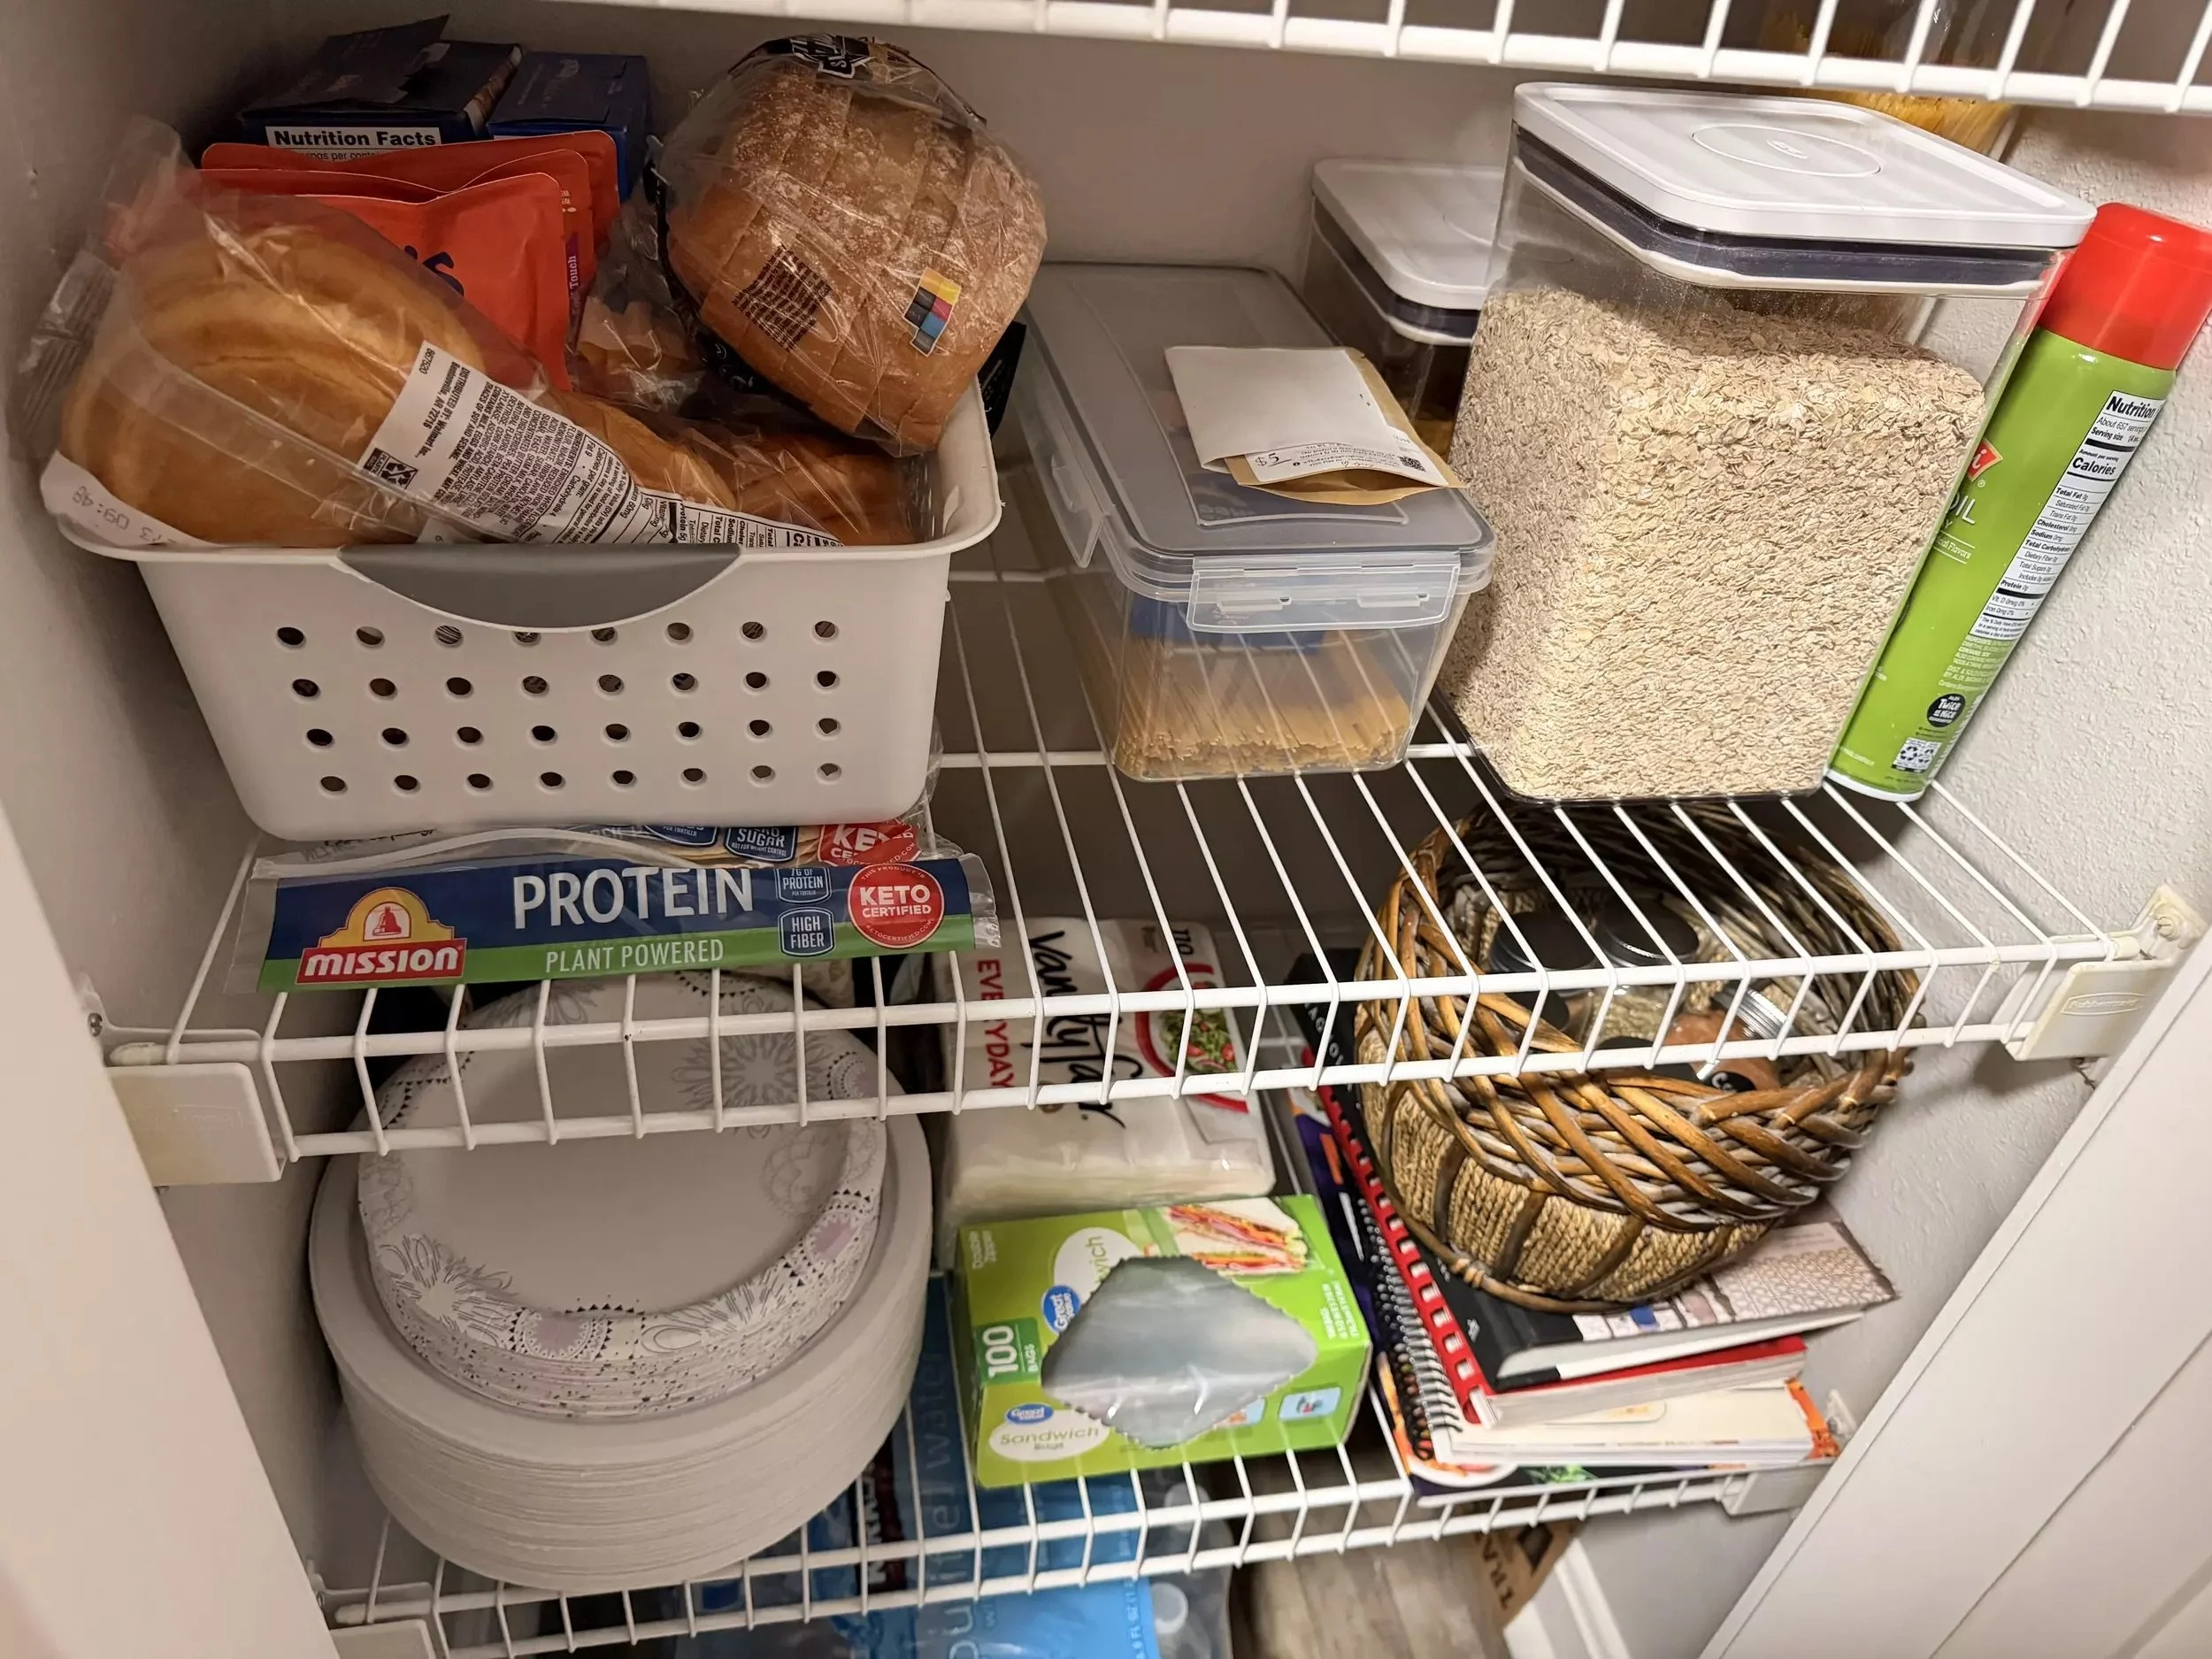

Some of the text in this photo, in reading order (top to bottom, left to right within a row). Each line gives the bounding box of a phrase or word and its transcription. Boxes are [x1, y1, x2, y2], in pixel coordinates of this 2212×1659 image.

[273, 130, 435, 146] Nutrition Facts
[331, 152, 347, 161] per
[567, 255, 580, 289] Touch
[424, 365, 471, 448] DISTRIBUTED BY: Walmart
[482, 384, 502, 414] CONTAINS
[2105, 395, 2157, 419] Nutrition
[421, 395, 444, 429] AR 72716
[448, 380, 493, 462] TRACES OF SOY AND SESAME.
[474, 411, 489, 431] MILK,
[521, 404, 534, 419] AND
[2095, 415, 2128, 430] About 657
[450, 388, 510, 492] XYLANASE, ASCORBIC ACID, PROTEASE,
[462, 394, 517, 491] DEXTROSE, CORN STARCH, AMYLASE,
[468, 428, 481, 447] EGGS
[505, 417, 528, 458] DIGLYCERIDES,
[2090, 426, 2114, 440] Serving
[2112, 432, 2124, 441] size
[461, 444, 474, 460] AND
[472, 399, 526, 494] NATURAL FLAVORS, BETA-CAROTENE
[491, 408, 542, 497] CONCENTRATED BUTTER (CREAM),
[562, 429, 585, 469] INGREDIENTS:
[585, 440, 595, 452] Fat
[2078, 449, 2098, 457] Amount
[499, 456, 511, 471] PEA
[501, 412, 551, 501] SUGAR, YEAST, SKIM MILK, WHEAT
[511, 416, 559, 500] ACID), WATER, SUGAR, CANOLA
[526, 420, 568, 496] MONONITRATE, RIBOFLAVIN,
[528, 424, 577, 507] FLOUR, NIACIN, REDUCED IRON,
[2070, 455, 2116, 476] Calories
[448, 457, 466, 478] WHEAT.
[574, 446, 606, 498] Calories per gram:
[439, 475, 454, 490] MAY
[485, 468, 504, 493] PROTEIN
[547, 466, 569, 496] ENRICHED
[596, 476, 607, 488] day
[607, 469, 620, 487] serving
[614, 479, 626, 492] Daily
[551, 473, 581, 513] Carbohydrate
[587, 491, 599, 504] used
[598, 491, 611, 503] food
[606, 491, 620, 506] Value
[2055, 487, 2072, 496] Total
[534, 494, 553, 512] WHEAT
[583, 502, 593, 511] for
[599, 504, 612, 517] (DV)
[619, 500, 636, 518] 60mg
[2055, 499, 2078, 511] Saturated
[571, 507, 588, 527] general
[581, 501, 603, 526] contributes
[2049, 510, 2064, 518] Trans
[697, 520, 709, 544] Dietary
[713, 514, 723, 533] Total
[2036, 518, 2070, 531] Cholesterol
[677, 531, 687, 541] 5g
[765, 526, 774, 547] Total
[2030, 528, 2053, 539] Sodium
[1947, 541, 1972, 559] Flavors
[2024, 539, 2041, 548] Total
[2024, 550, 2042, 560] Dietary
[2000, 579, 2022, 589] Protein
[737, 829, 785, 848] SUGAR
[769, 848, 787, 856] CONTROL
[782, 875, 825, 890] PROTEIN
[861, 869, 876, 881] THIS
[877, 865, 918, 875] PRODUCT
[513, 866, 754, 929] PROTEIN
[859, 885, 931, 906] KETO
[861, 905, 933, 919] CERTIFIED
[792, 915, 821, 933] HIGH
[865, 919, 933, 942] KETOCERTIFIED.COM
[790, 932, 826, 949] FIBER
[1172, 928, 1194, 956] 110
[545, 939, 724, 973] PLANT POWERED
[978, 959, 1016, 1088] EVEYDAY
[1051, 1293, 1069, 1330] Great
[983, 1325, 1018, 1377] 100
[1025, 1343, 1039, 1372] BAGS
[1010, 1405, 1045, 1417] Great
[999, 1425, 1099, 1446] Sandwich
